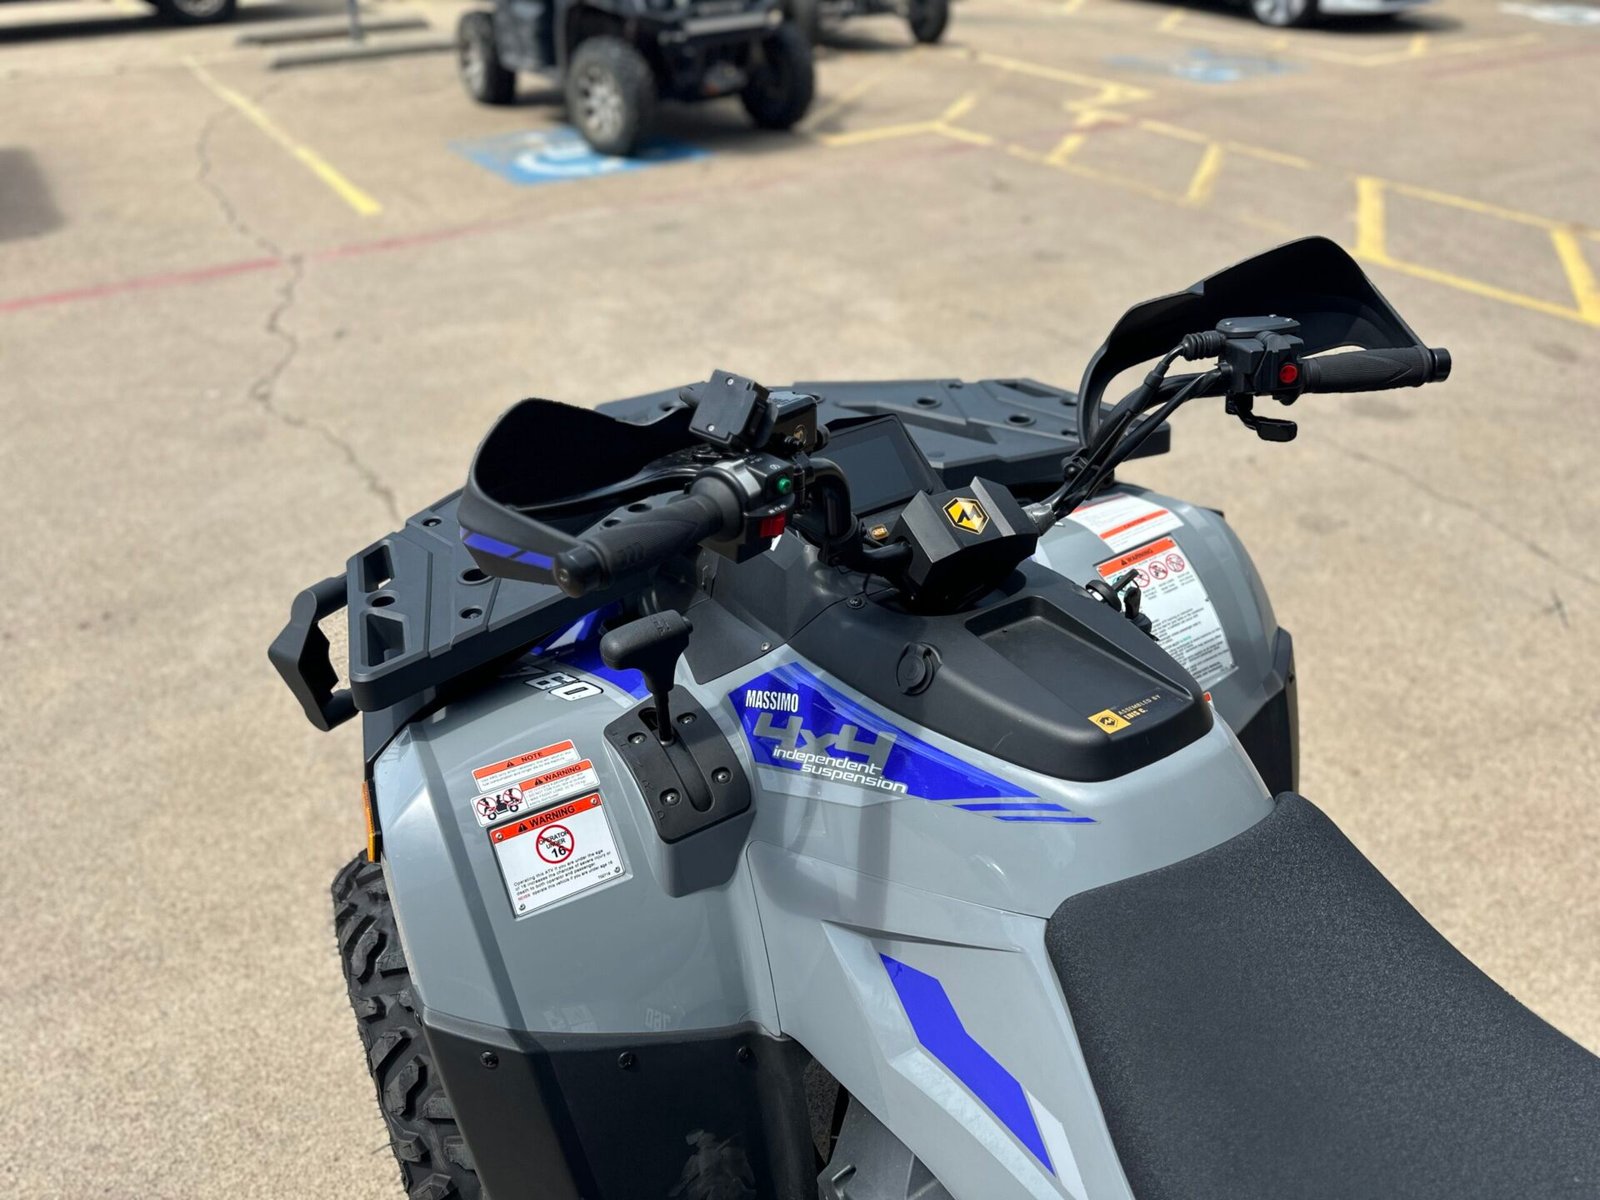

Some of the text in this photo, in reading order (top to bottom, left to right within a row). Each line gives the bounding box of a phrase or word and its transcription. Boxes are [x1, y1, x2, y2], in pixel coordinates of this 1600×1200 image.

[1126, 548, 1154, 563] WARNING
[745, 689, 799, 713] MASSIMO
[752, 711, 898, 778] 4x4
[521, 751, 543, 762] NOTE
[772, 745, 882, 775] independent
[543, 765, 581, 781] WARNING
[801, 763, 908, 794] suspension
[528, 805, 576, 828] WARNING
[538, 830, 570, 846] OPERATOR
[545, 837, 566, 849] UNDER
[551, 845, 567, 858] 16
